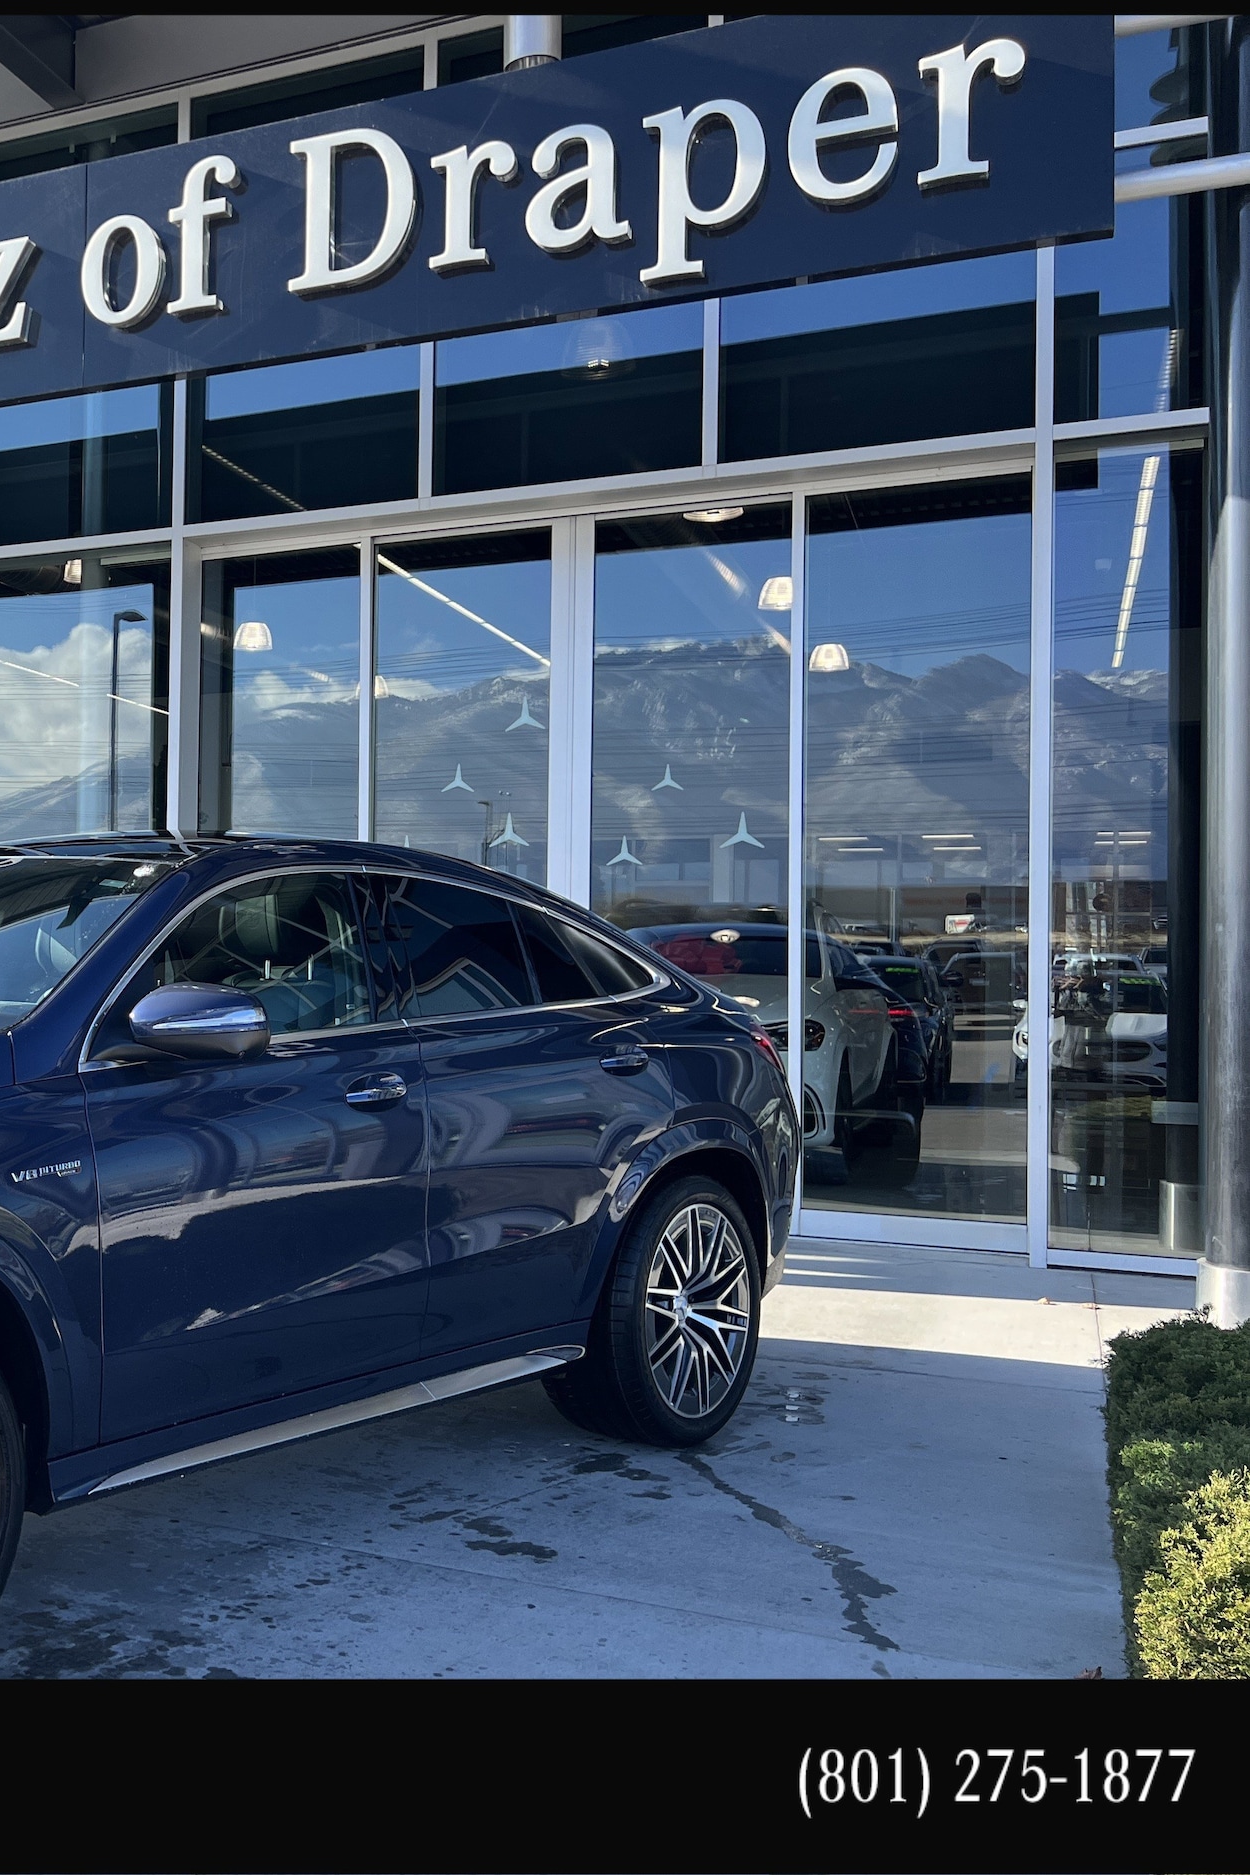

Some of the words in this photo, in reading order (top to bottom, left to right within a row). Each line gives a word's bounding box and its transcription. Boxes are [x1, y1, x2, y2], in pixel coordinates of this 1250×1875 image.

[81, 154, 237, 328] of
[287, 37, 1026, 288] Draper
[11, 1168, 37, 1183] V8
